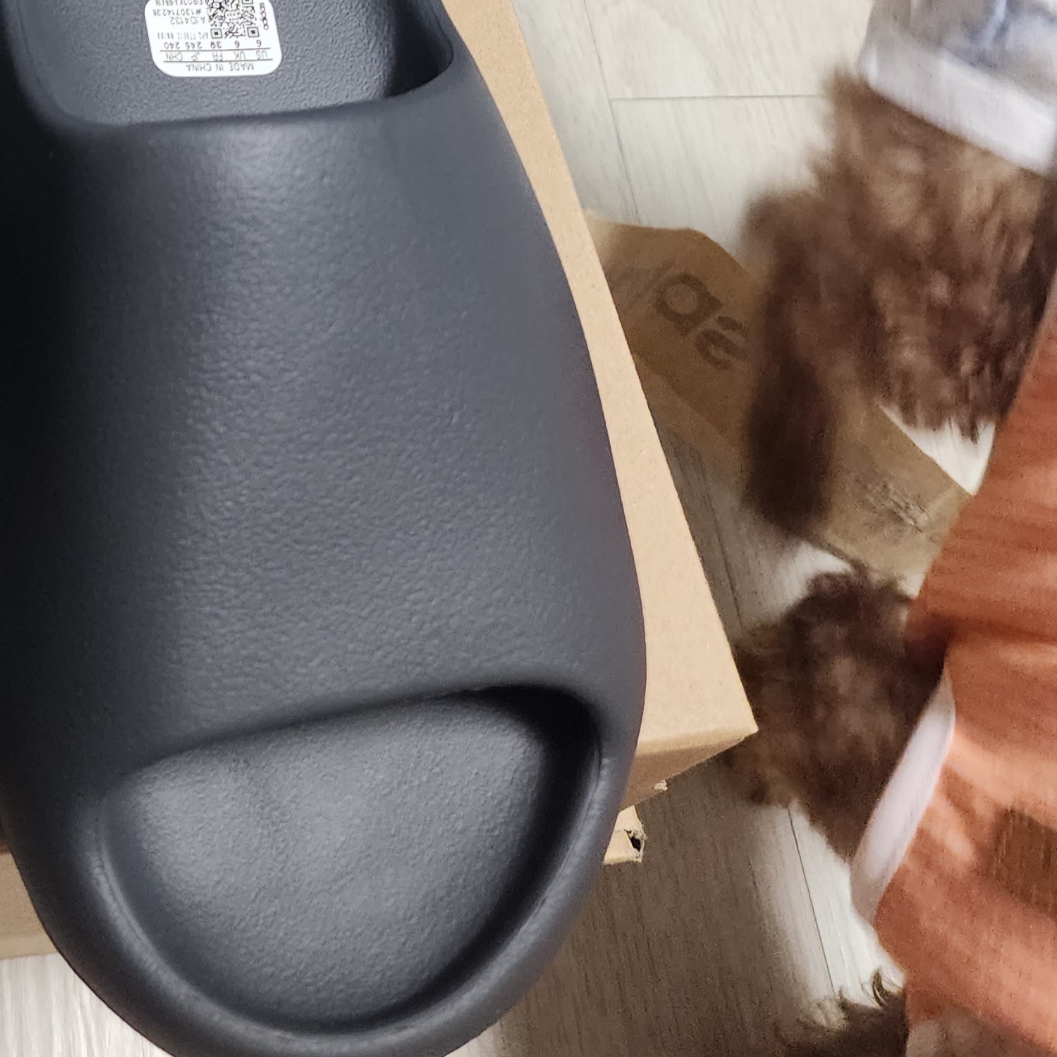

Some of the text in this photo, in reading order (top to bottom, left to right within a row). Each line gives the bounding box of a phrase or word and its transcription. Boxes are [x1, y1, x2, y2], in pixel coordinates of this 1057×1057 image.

[163, 41, 181, 49] 240
[186, 62, 255, 72] MADE IN CHINA
